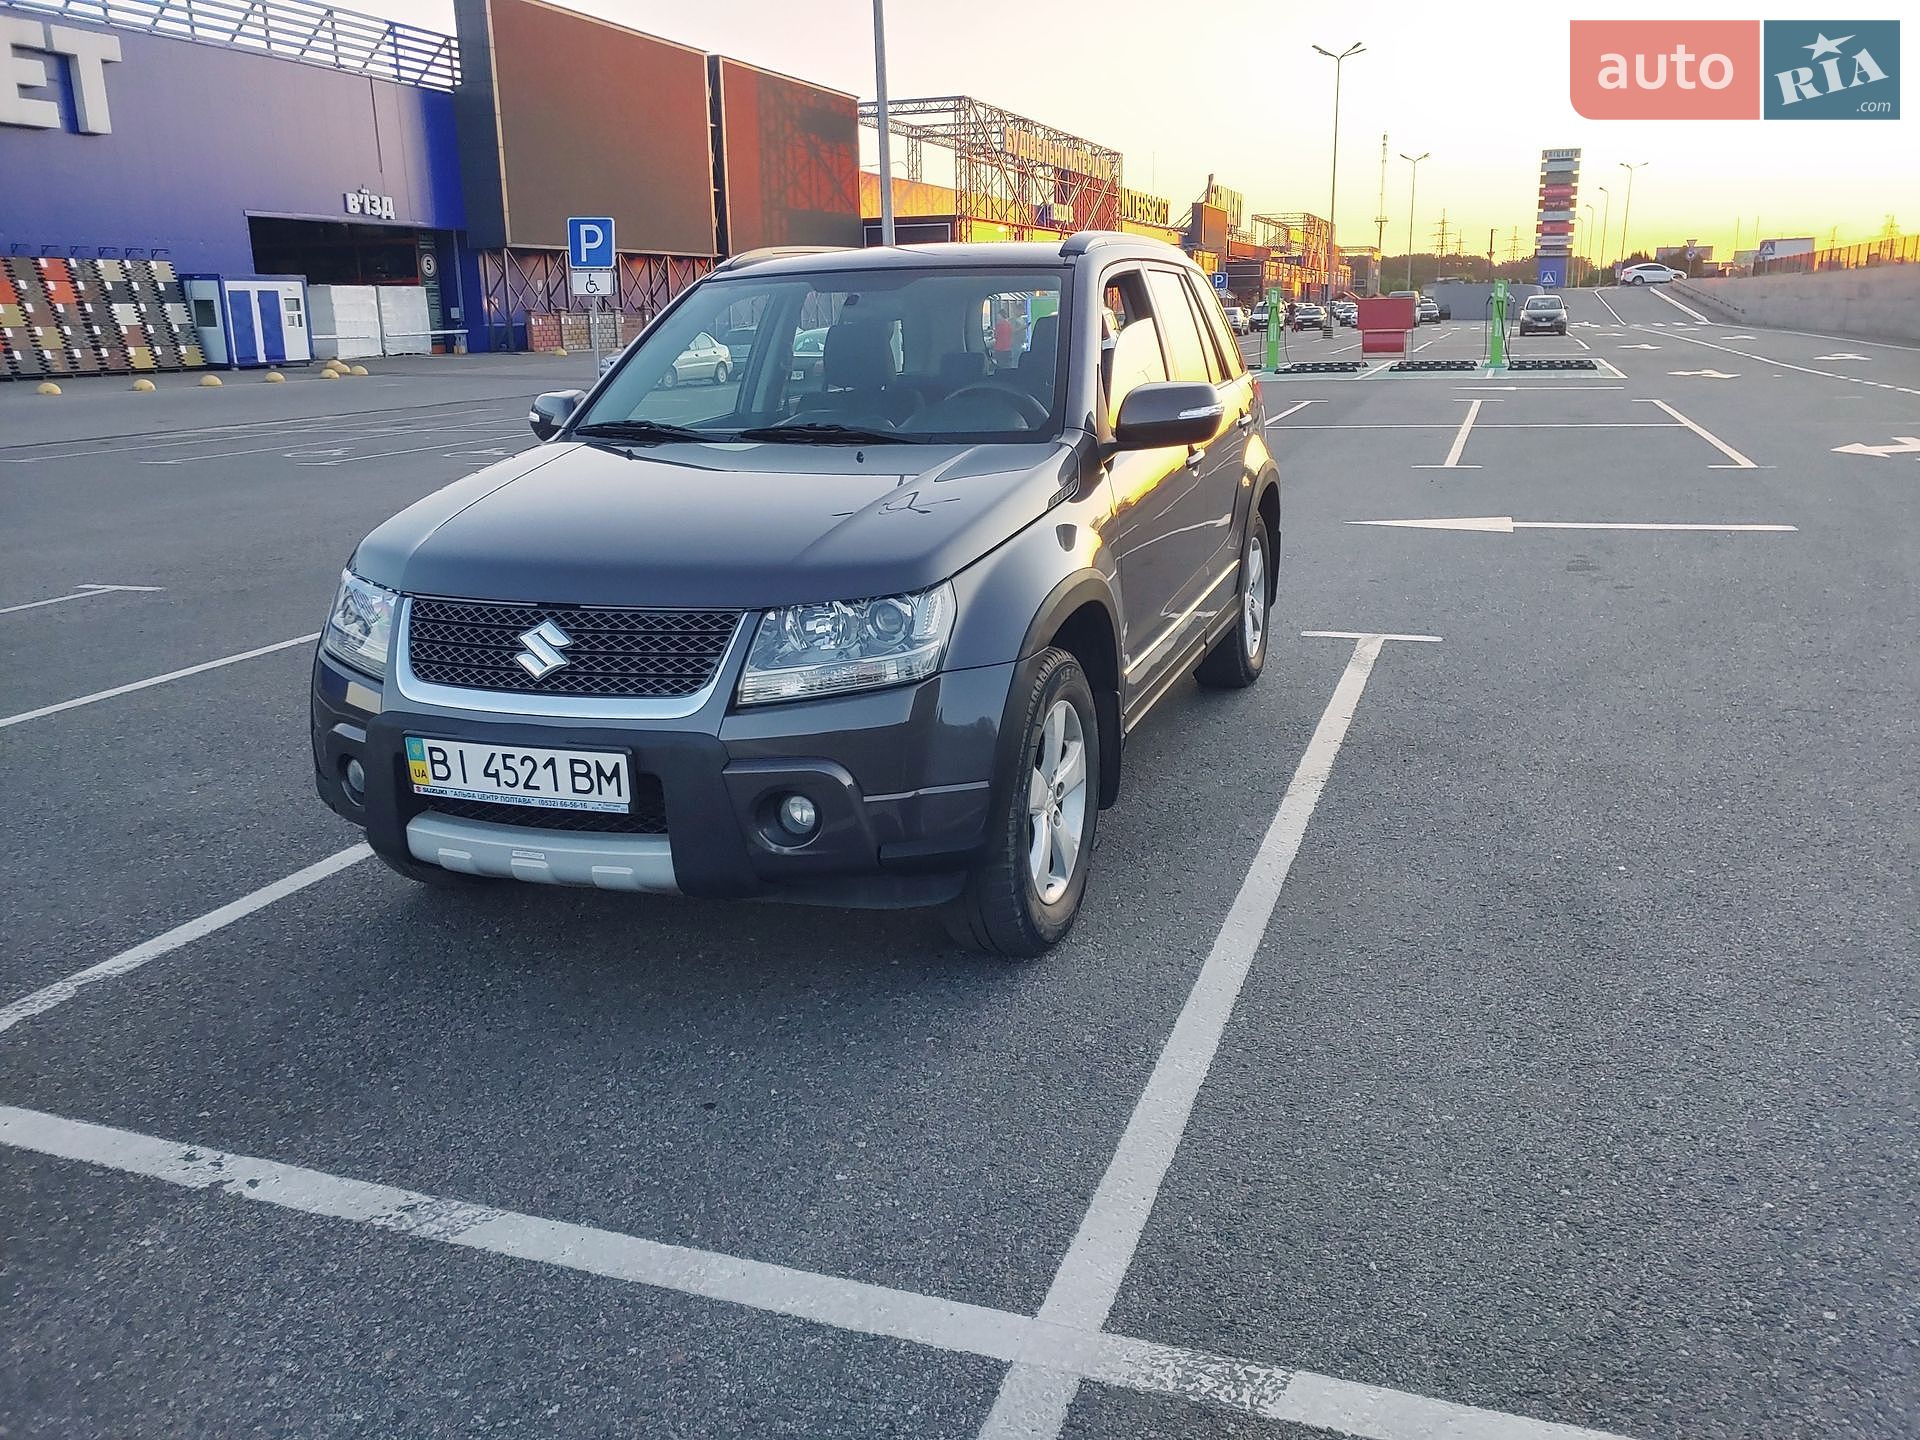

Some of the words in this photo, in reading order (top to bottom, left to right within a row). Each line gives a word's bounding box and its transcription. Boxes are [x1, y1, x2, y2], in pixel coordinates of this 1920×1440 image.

[1122, 187, 1171, 225] INTERSPORT
[580, 225, 603, 262] P
[426, 260, 432, 270] 5
[1215, 275, 1224, 287] P
[414, 768, 428, 780] UA
[427, 746, 468, 784] BI
[483, 752, 560, 792] 4521
[569, 758, 622, 797] BM
[422, 786, 448, 795] SUZUKI
[478, 793, 499, 802] ЦЕНТР
[538, 799, 558, 808] (0532)
